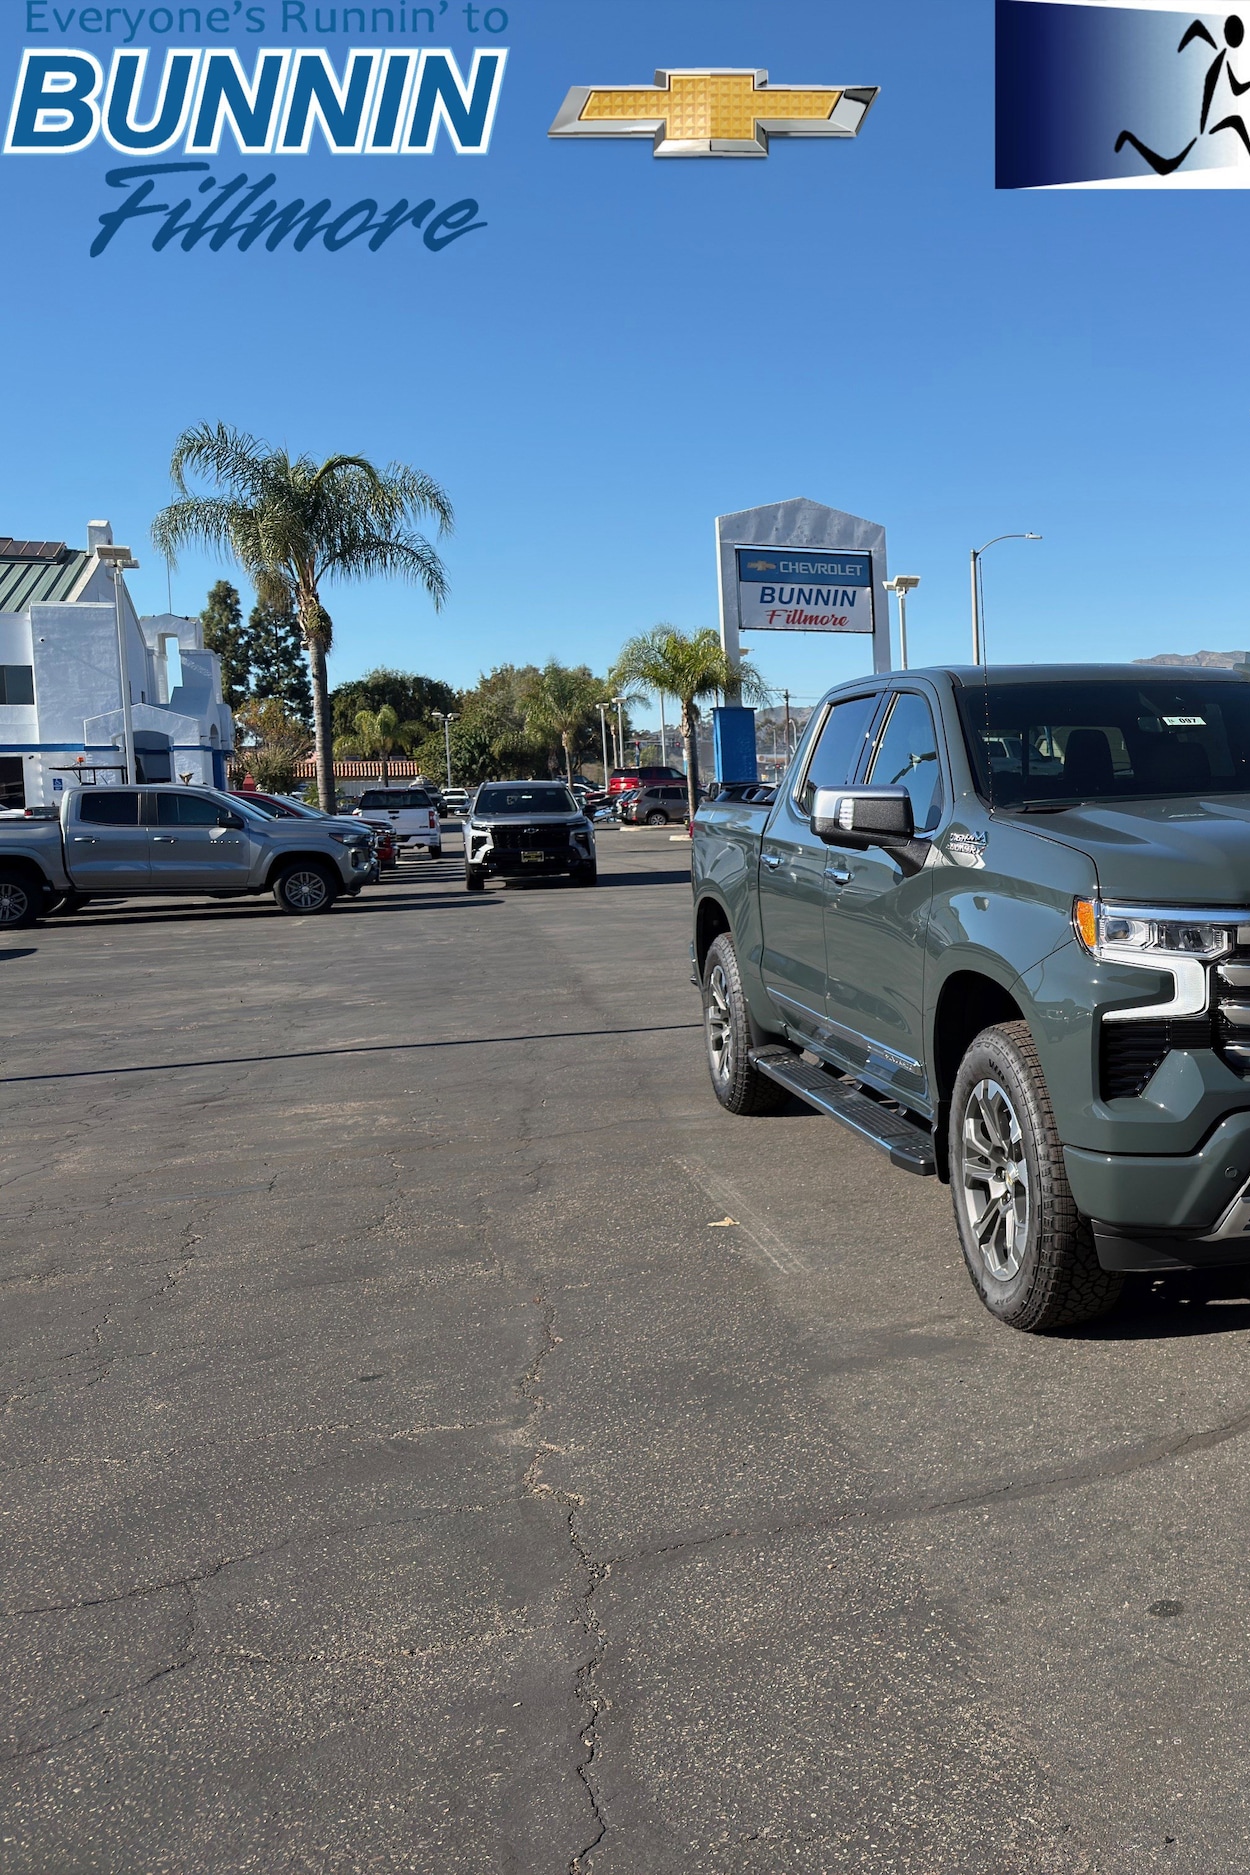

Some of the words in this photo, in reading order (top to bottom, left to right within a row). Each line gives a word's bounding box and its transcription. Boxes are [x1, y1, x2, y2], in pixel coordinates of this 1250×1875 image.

[779, 561, 863, 577] CHEVROLET
[759, 586, 857, 607] BUNNIN
[765, 609, 849, 627] Fillmore
